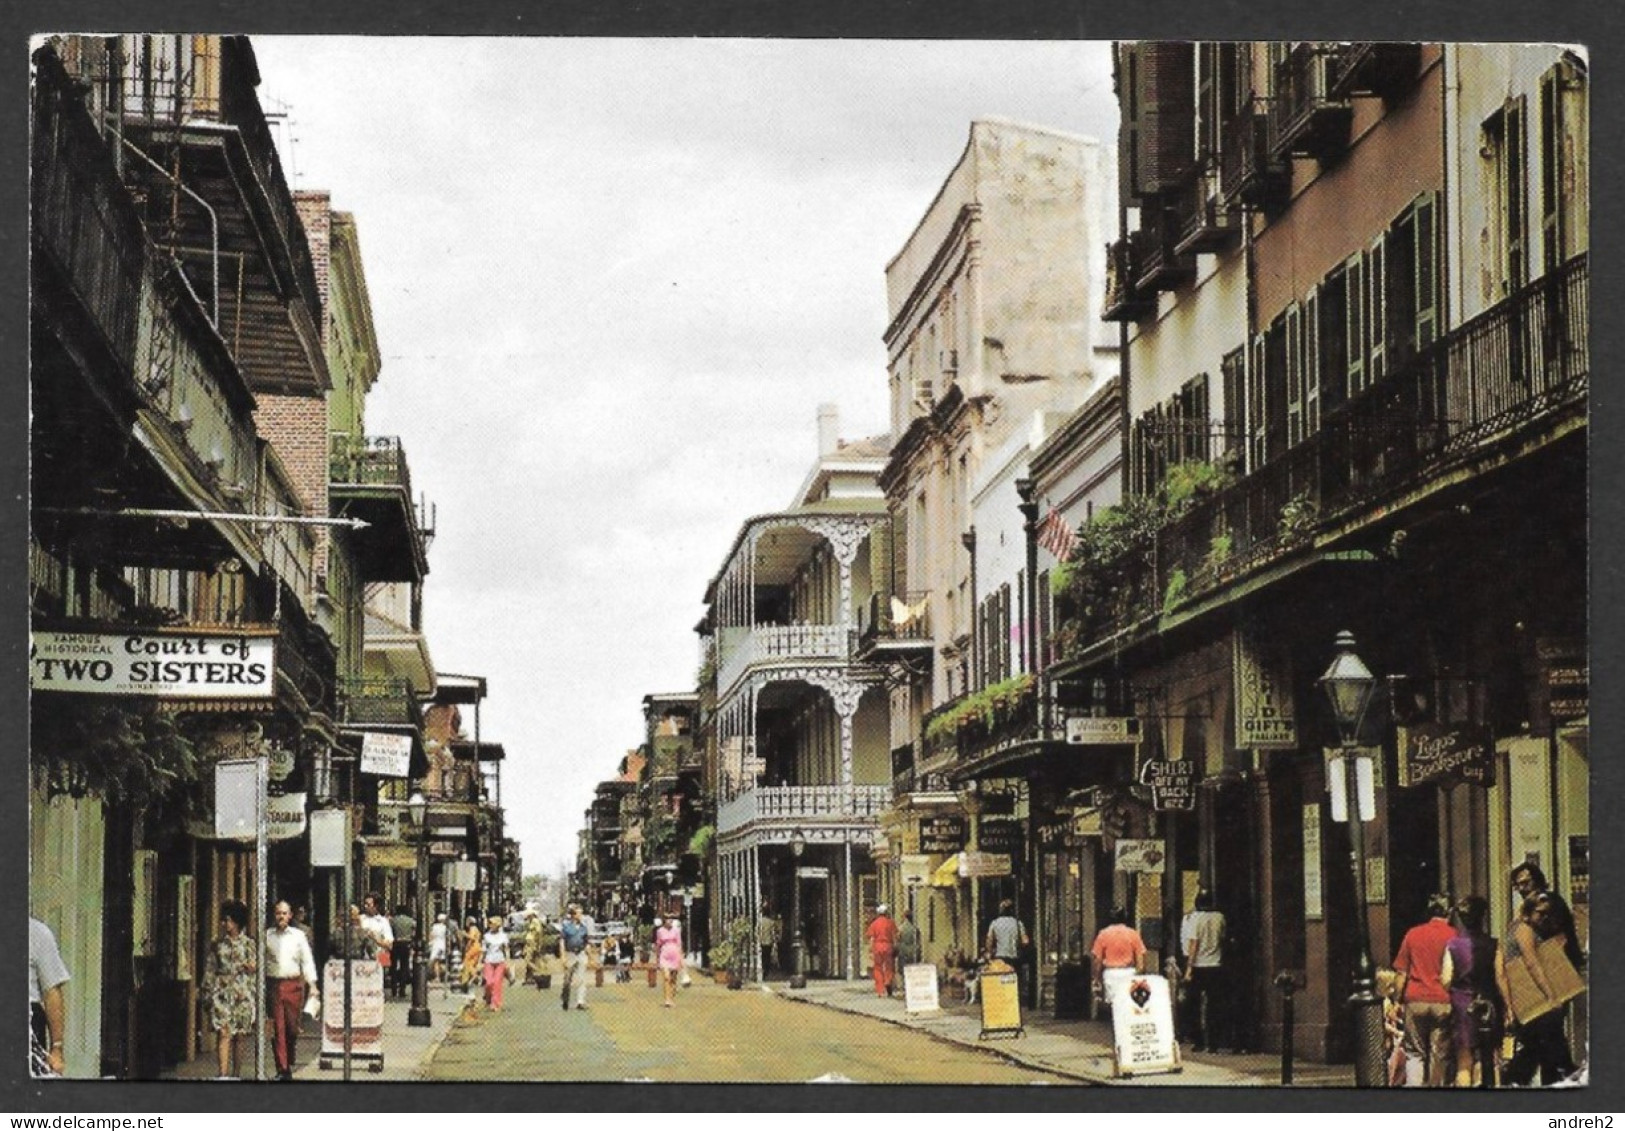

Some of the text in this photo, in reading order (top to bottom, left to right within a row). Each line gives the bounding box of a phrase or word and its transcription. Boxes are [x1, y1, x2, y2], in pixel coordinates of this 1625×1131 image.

[54, 634, 101, 643] FAMOUS
[46, 643, 113, 654] HISTORICAL
[124, 635, 250, 661] Court of
[37, 658, 266, 684] TWO SISTERS
[1151, 761, 1194, 777] SHIRT
[1159, 787, 1189, 797] BACK
